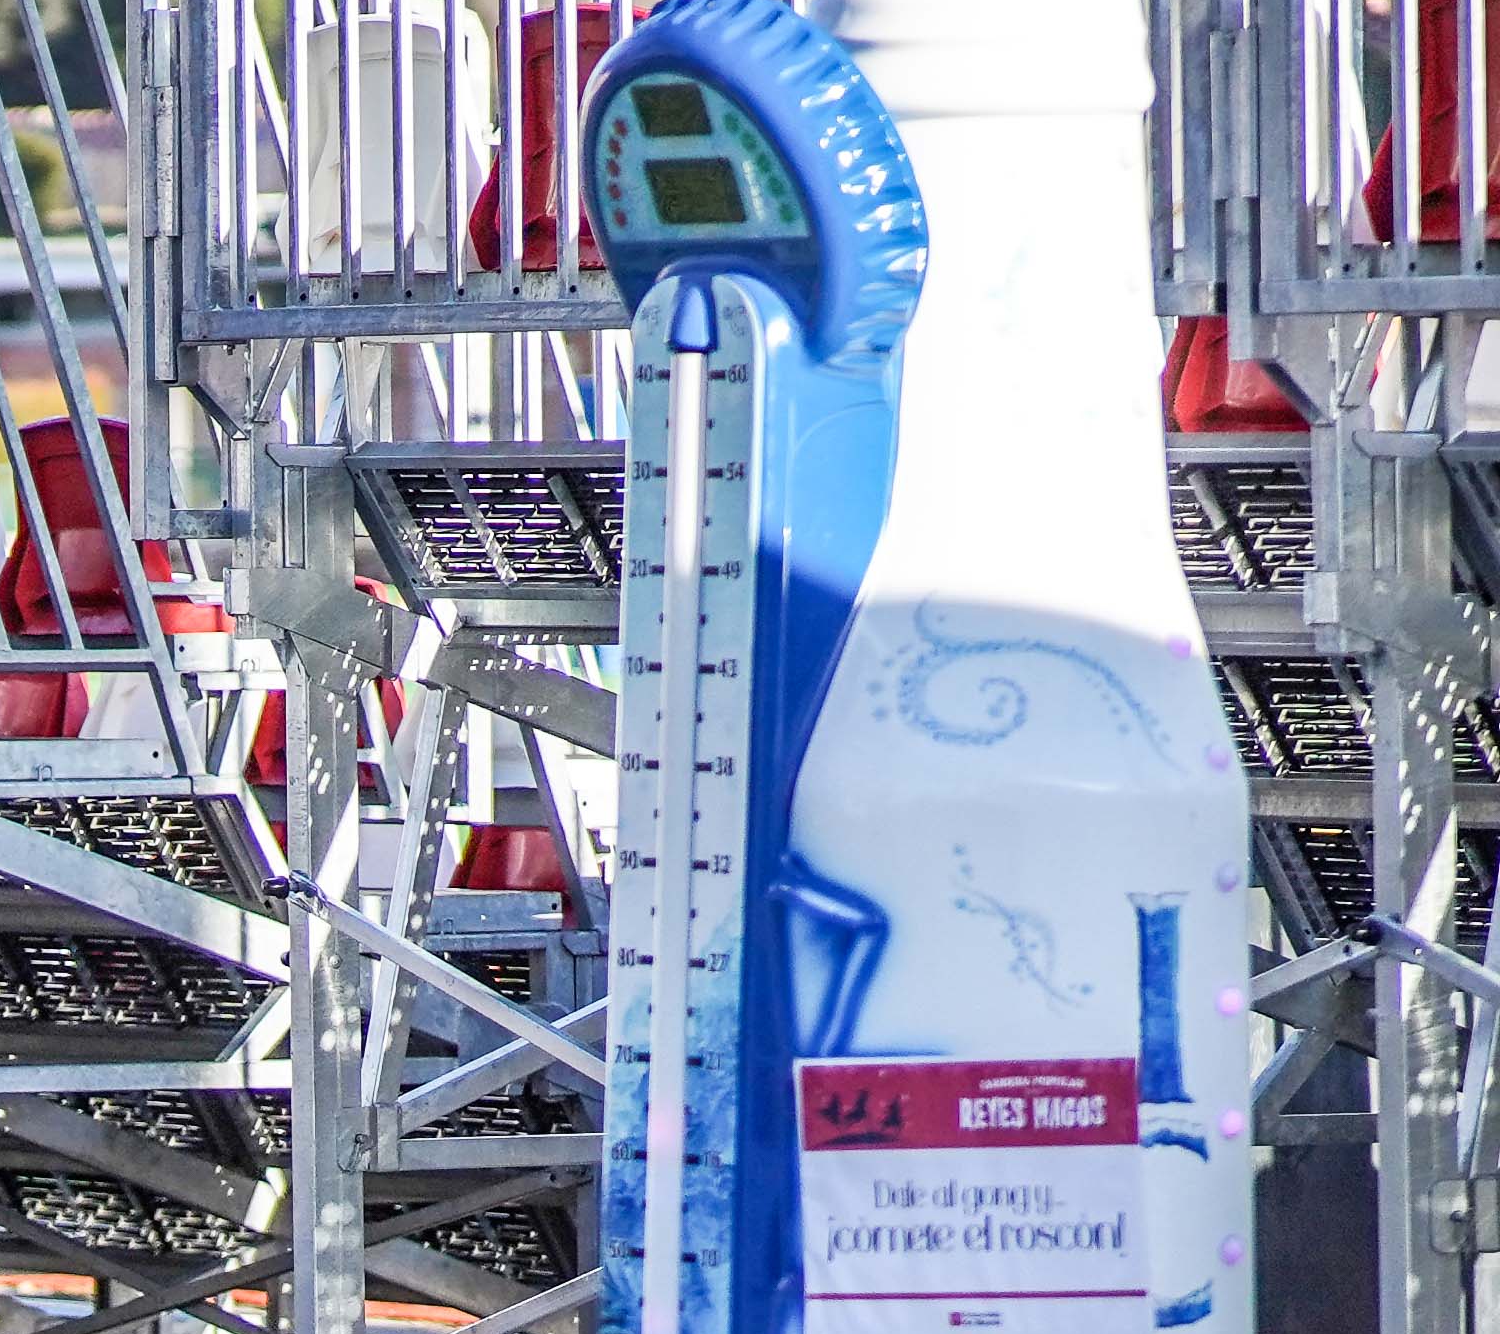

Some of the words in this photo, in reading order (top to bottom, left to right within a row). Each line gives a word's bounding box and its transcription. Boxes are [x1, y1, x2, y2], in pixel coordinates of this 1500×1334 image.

[958, 1096, 1027, 1130] REYES
[1032, 1095, 1108, 1130] MAGOS
[932, 1178, 958, 1208] al
[963, 1213, 993, 1252] el
